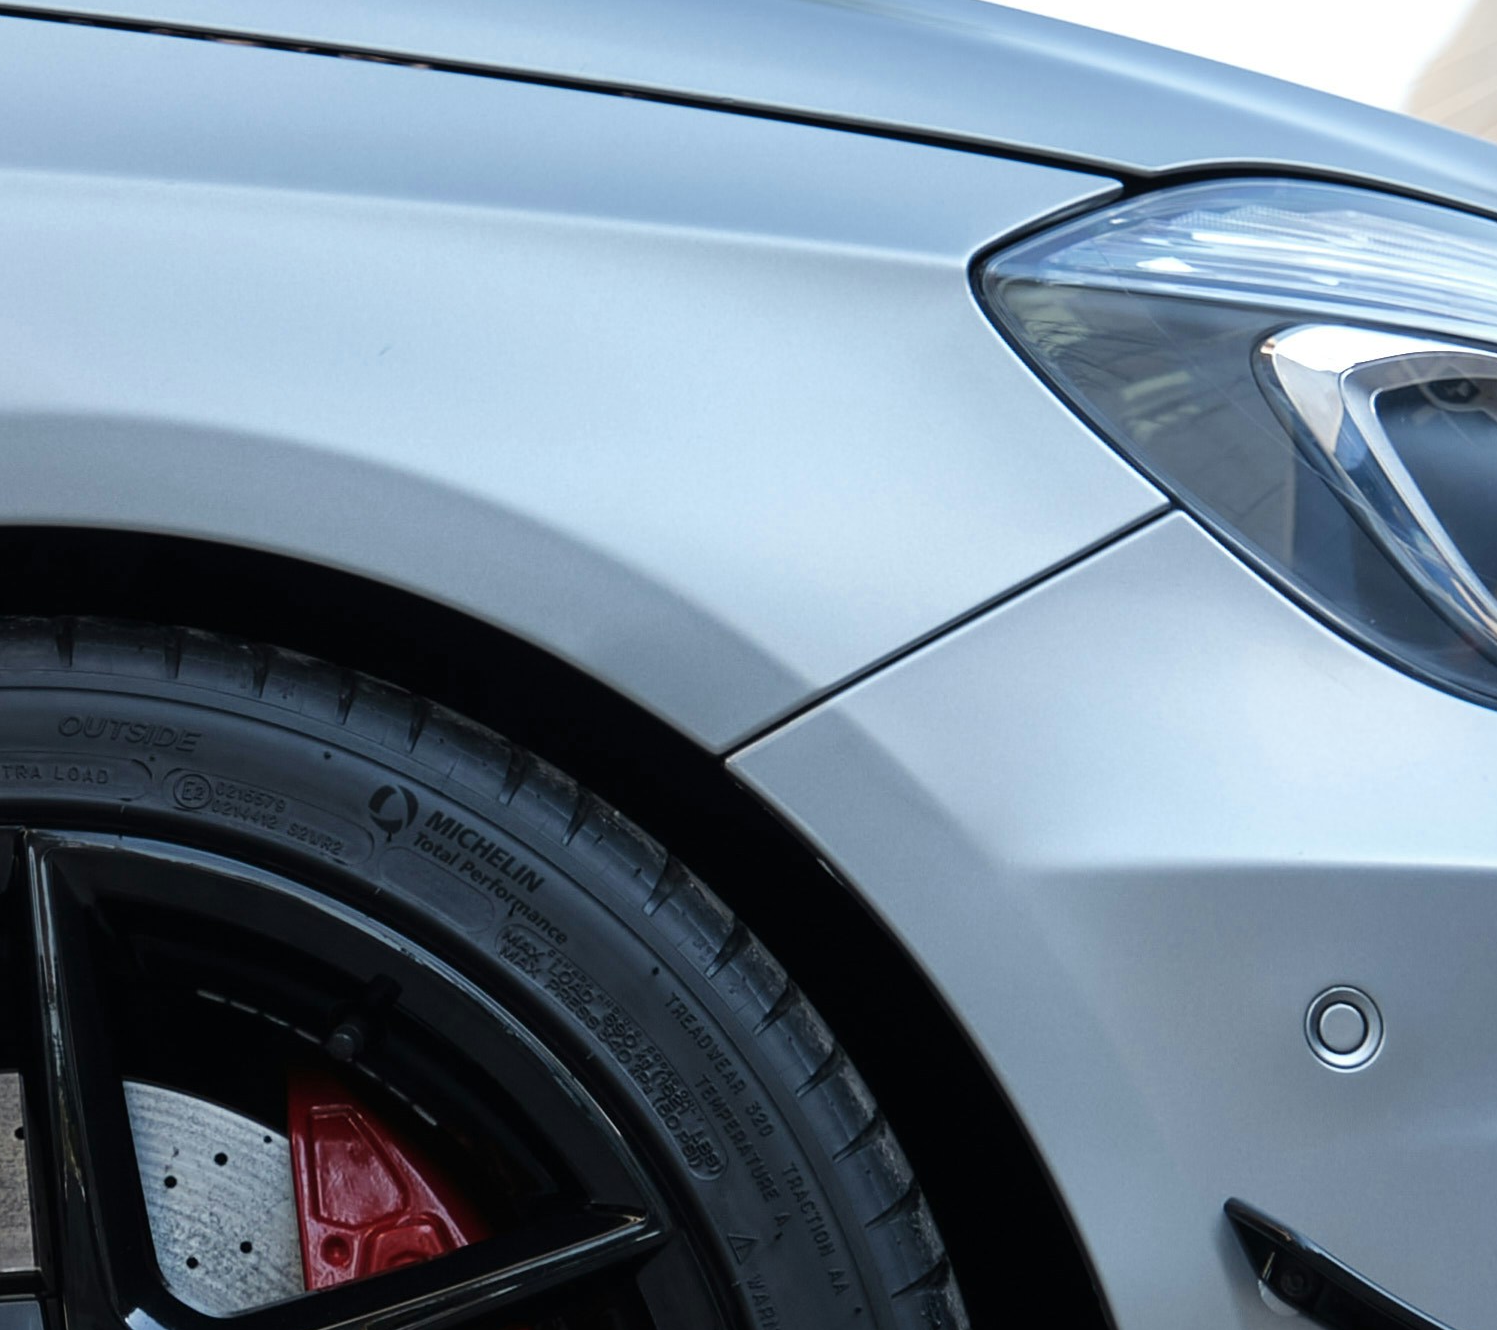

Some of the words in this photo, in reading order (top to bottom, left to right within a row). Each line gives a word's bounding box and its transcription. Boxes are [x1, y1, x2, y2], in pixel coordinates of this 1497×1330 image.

[57, 713, 202, 755] OUTSIDE
[52, 764, 110, 785] LOAD
[423, 805, 546, 896] MICHELIN
[409, 829, 462, 869] Total
[456, 857, 571, 948] Performance
[543, 975, 601, 1033] PRESS
[546, 959, 596, 1007] LOAD
[659, 988, 748, 1097] TREADWEAR
[741, 1098, 776, 1140] 320
[778, 1159, 837, 1259] TRACTION
[824, 1264, 852, 1299] AA
[689, 1069, 781, 1204] TEMPERATURE
[772, 1208, 794, 1229] A
